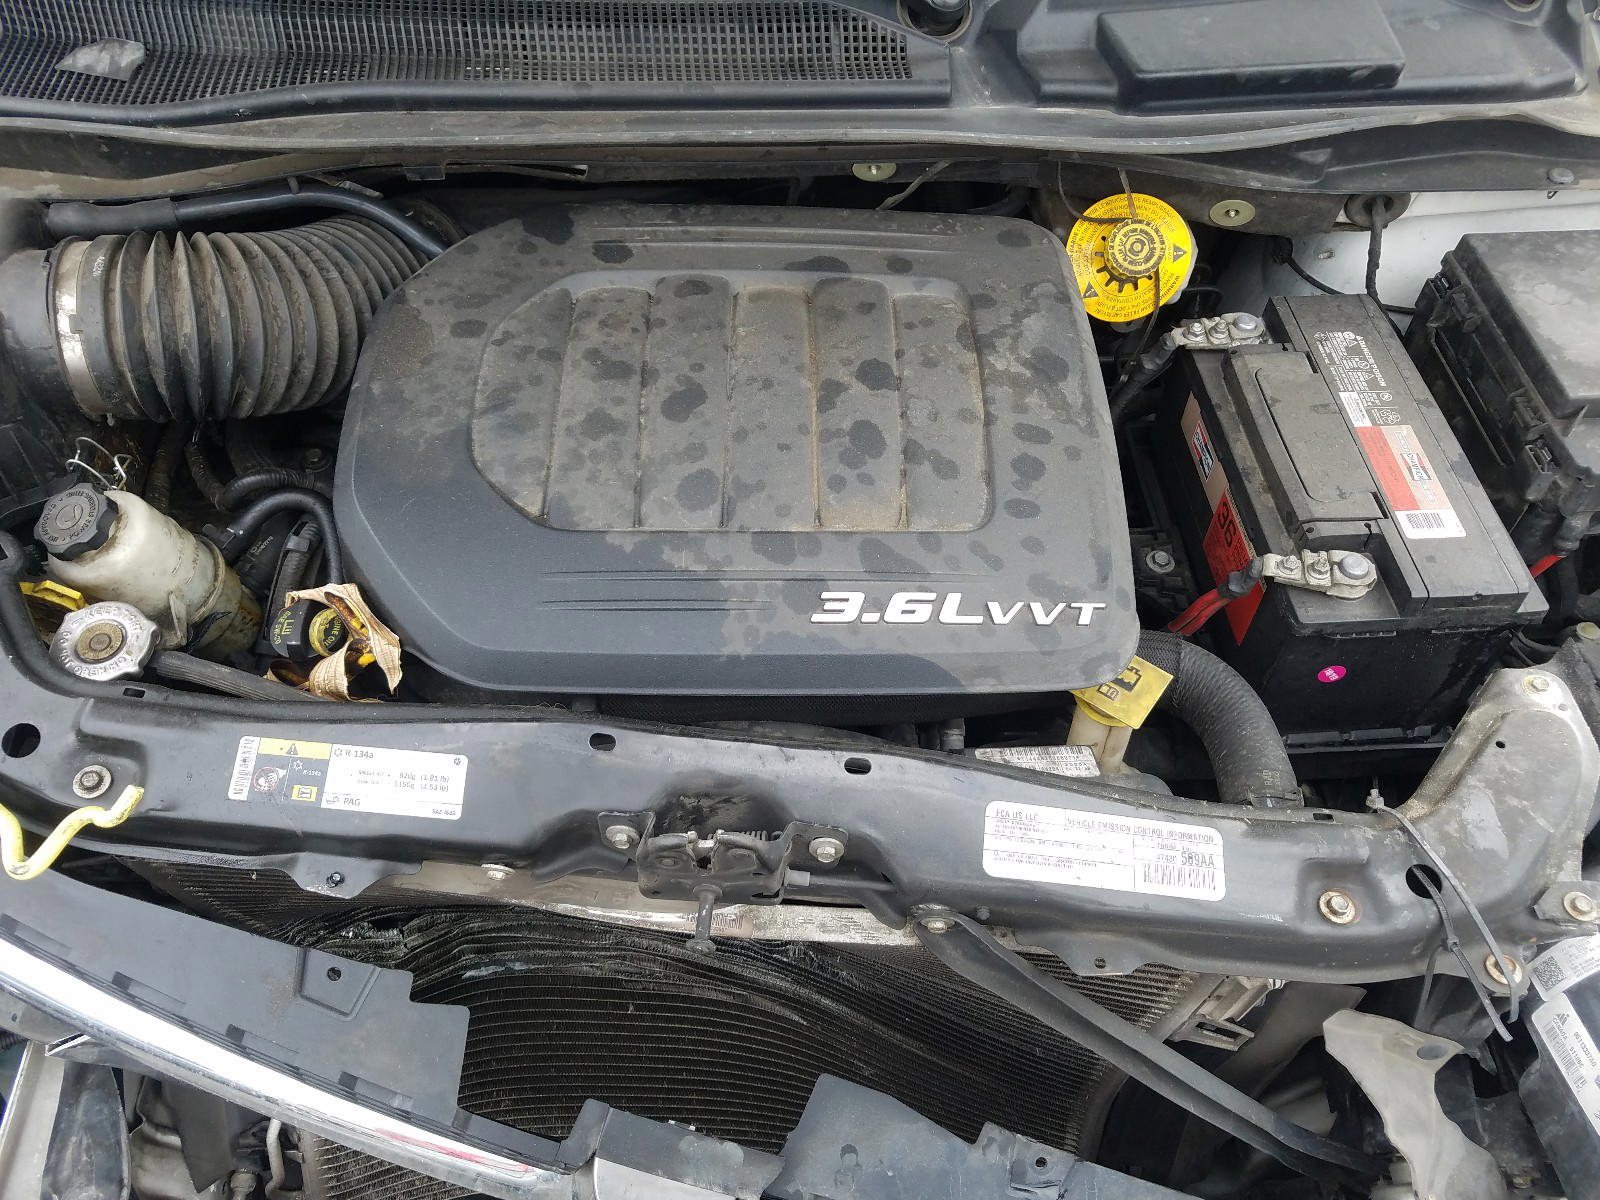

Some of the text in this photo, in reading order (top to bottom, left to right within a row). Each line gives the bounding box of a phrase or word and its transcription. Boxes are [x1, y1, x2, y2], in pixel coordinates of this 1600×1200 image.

[810, 592, 1106, 626] 3.6L VVT
[343, 798, 360, 806] PAG
[1012, 811, 1023, 820] US
[1098, 820, 1131, 833] EMISSION
[1133, 826, 1164, 838] CONTROL
[1166, 830, 1214, 842] INFORMATION
